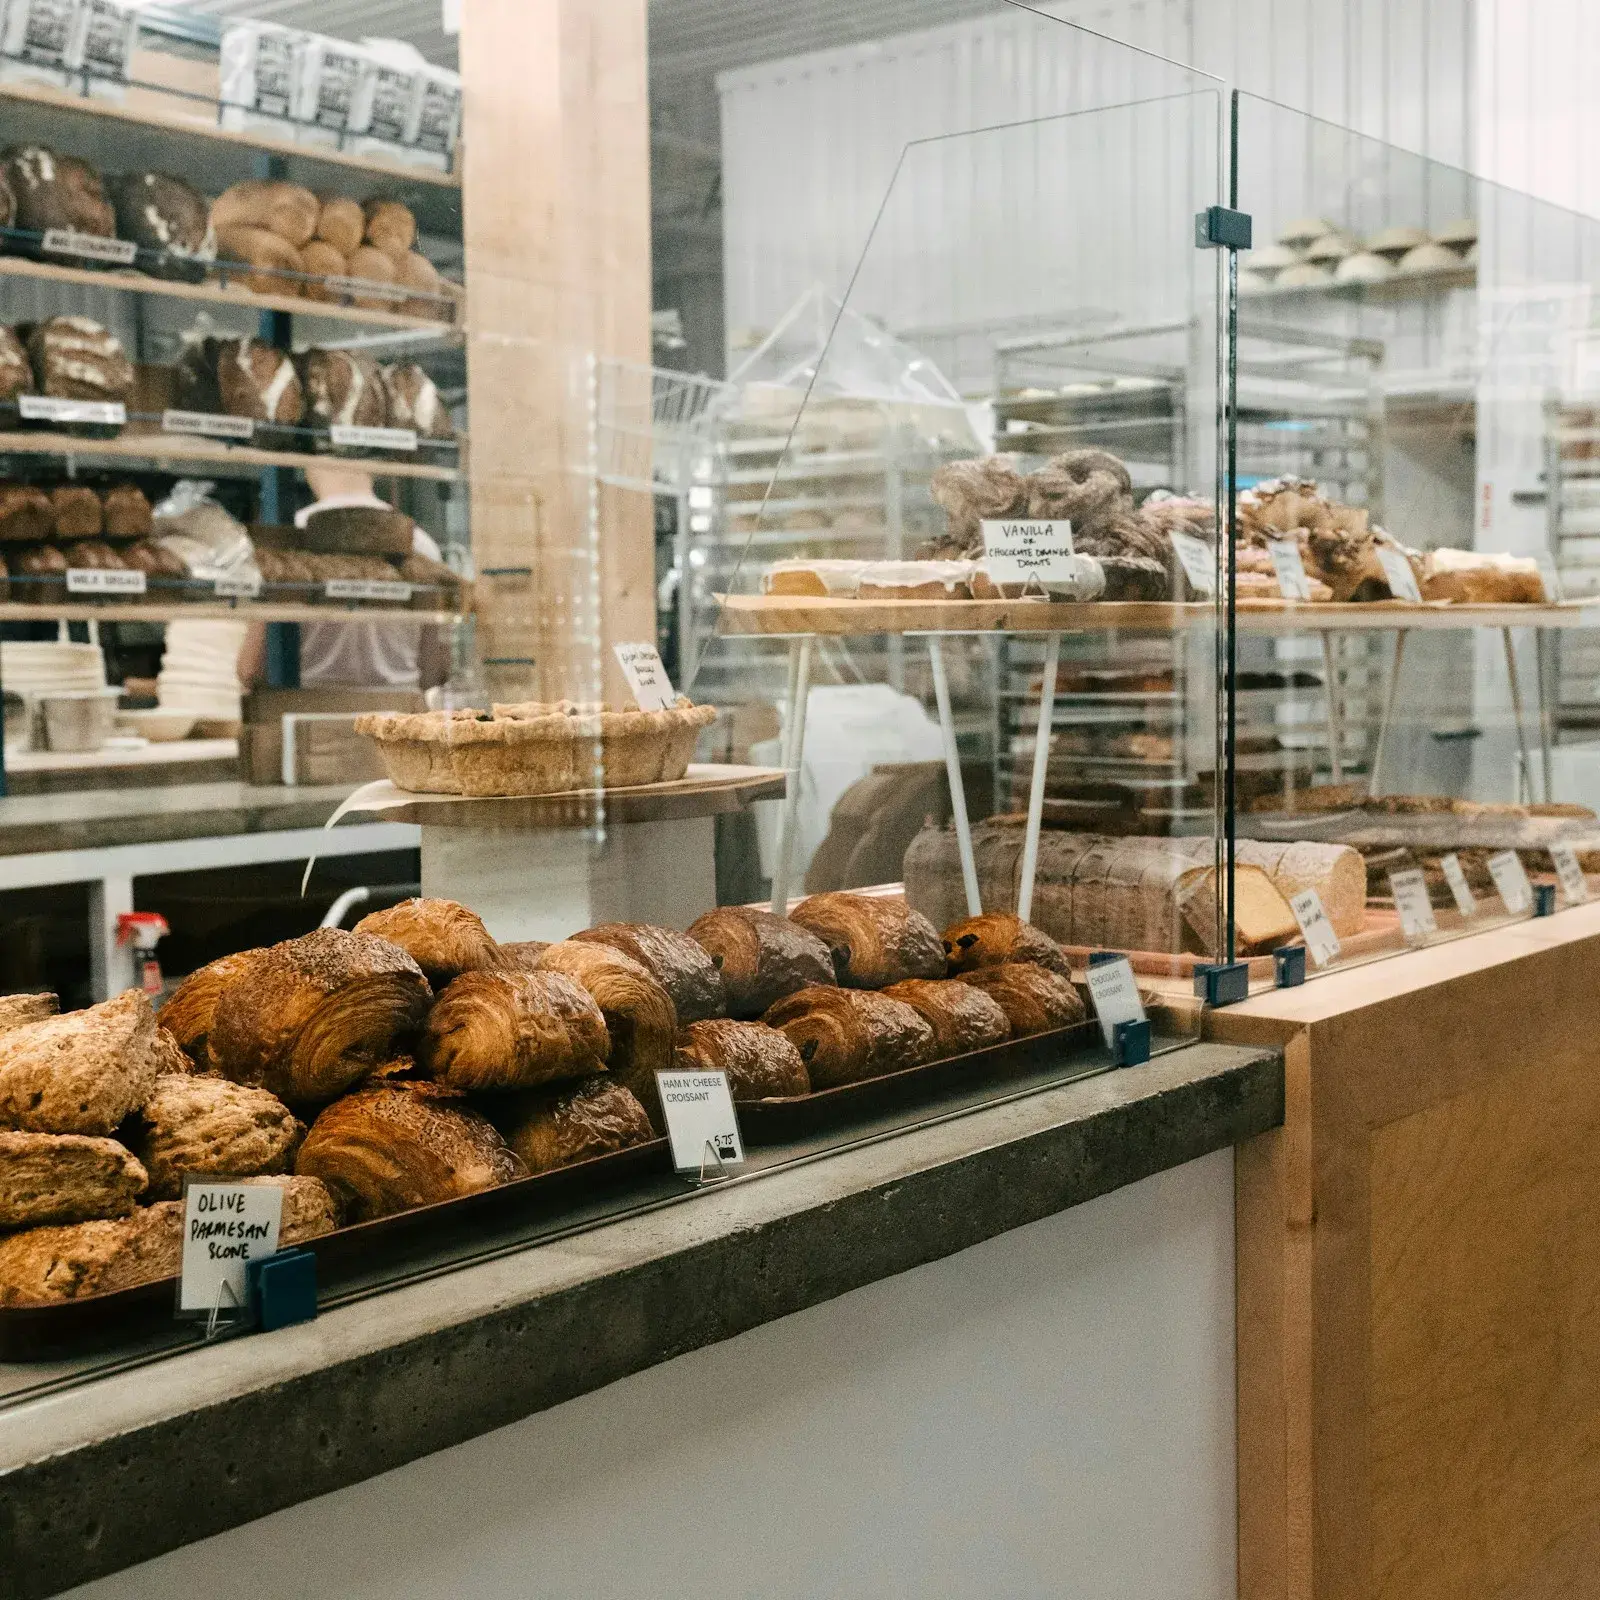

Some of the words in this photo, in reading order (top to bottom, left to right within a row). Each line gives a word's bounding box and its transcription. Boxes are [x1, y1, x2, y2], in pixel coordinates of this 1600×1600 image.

[1001, 524, 1055, 538] VANILLA
[988, 547, 1033, 558] CHOCOLATE
[1091, 970, 1121, 985] CHOCOLATE
[663, 1078, 682, 1089] HAM
[692, 1077, 722, 1087] CHEESE
[666, 1092, 710, 1102] CROISSANT
[714, 1133, 735, 1147] 5.75
[198, 1193, 246, 1214] OLIVE
[191, 1218, 270, 1241] PARMESAN
[208, 1242, 250, 1260] SCONE
